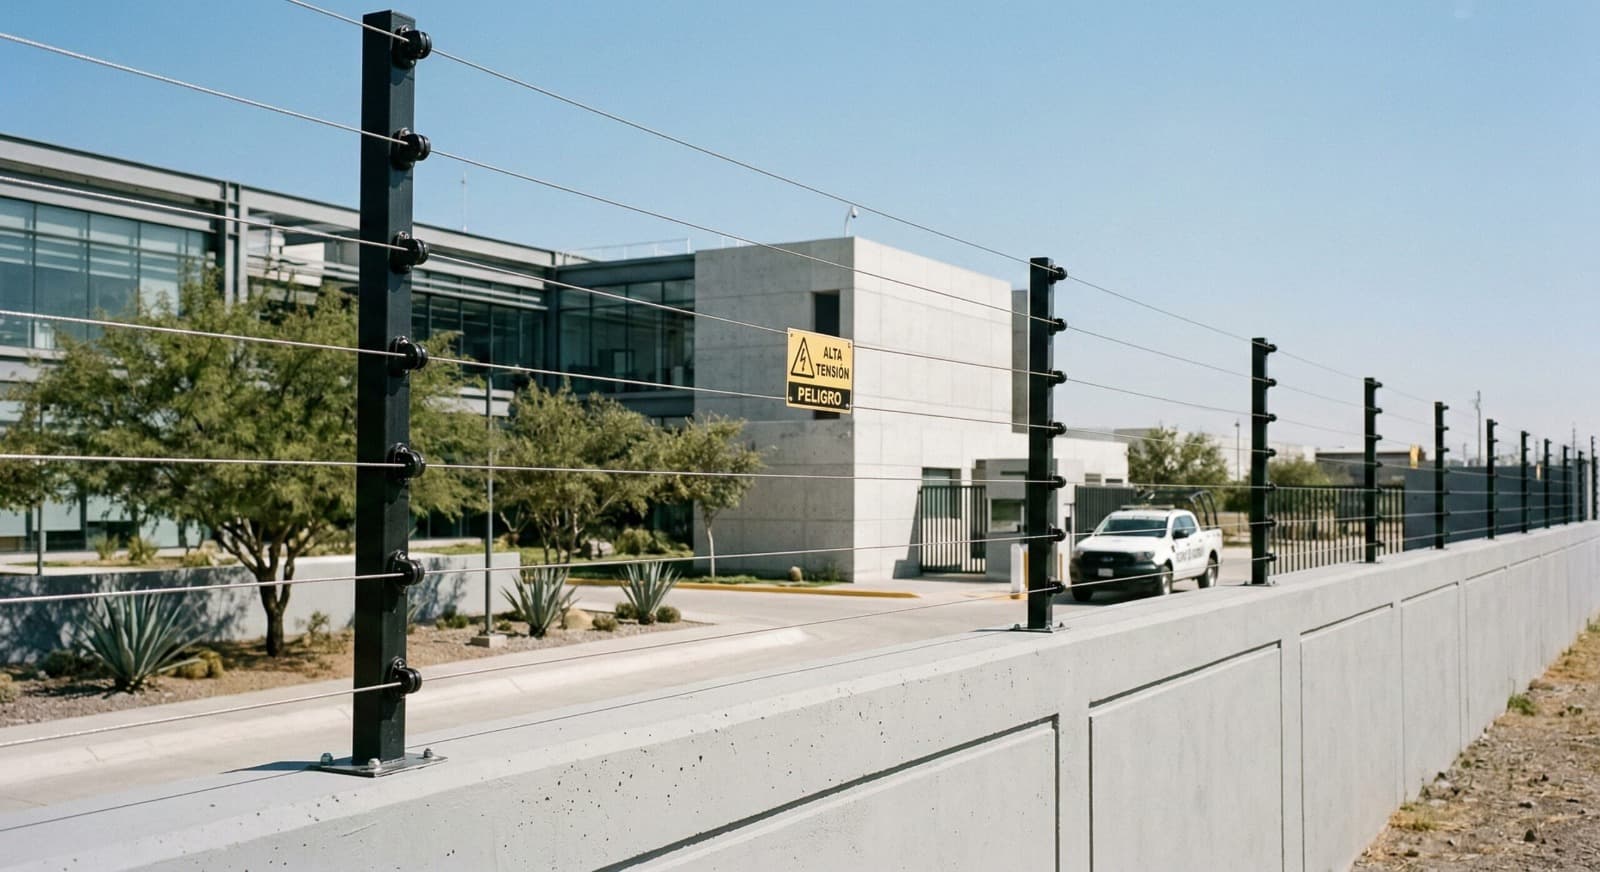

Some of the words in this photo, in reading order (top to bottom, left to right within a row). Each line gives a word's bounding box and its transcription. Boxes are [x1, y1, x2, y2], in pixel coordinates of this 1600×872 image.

[823, 346, 843, 361] ALTA
[816, 363, 849, 380] TENSIÓN
[797, 386, 842, 406] PELIGRO
